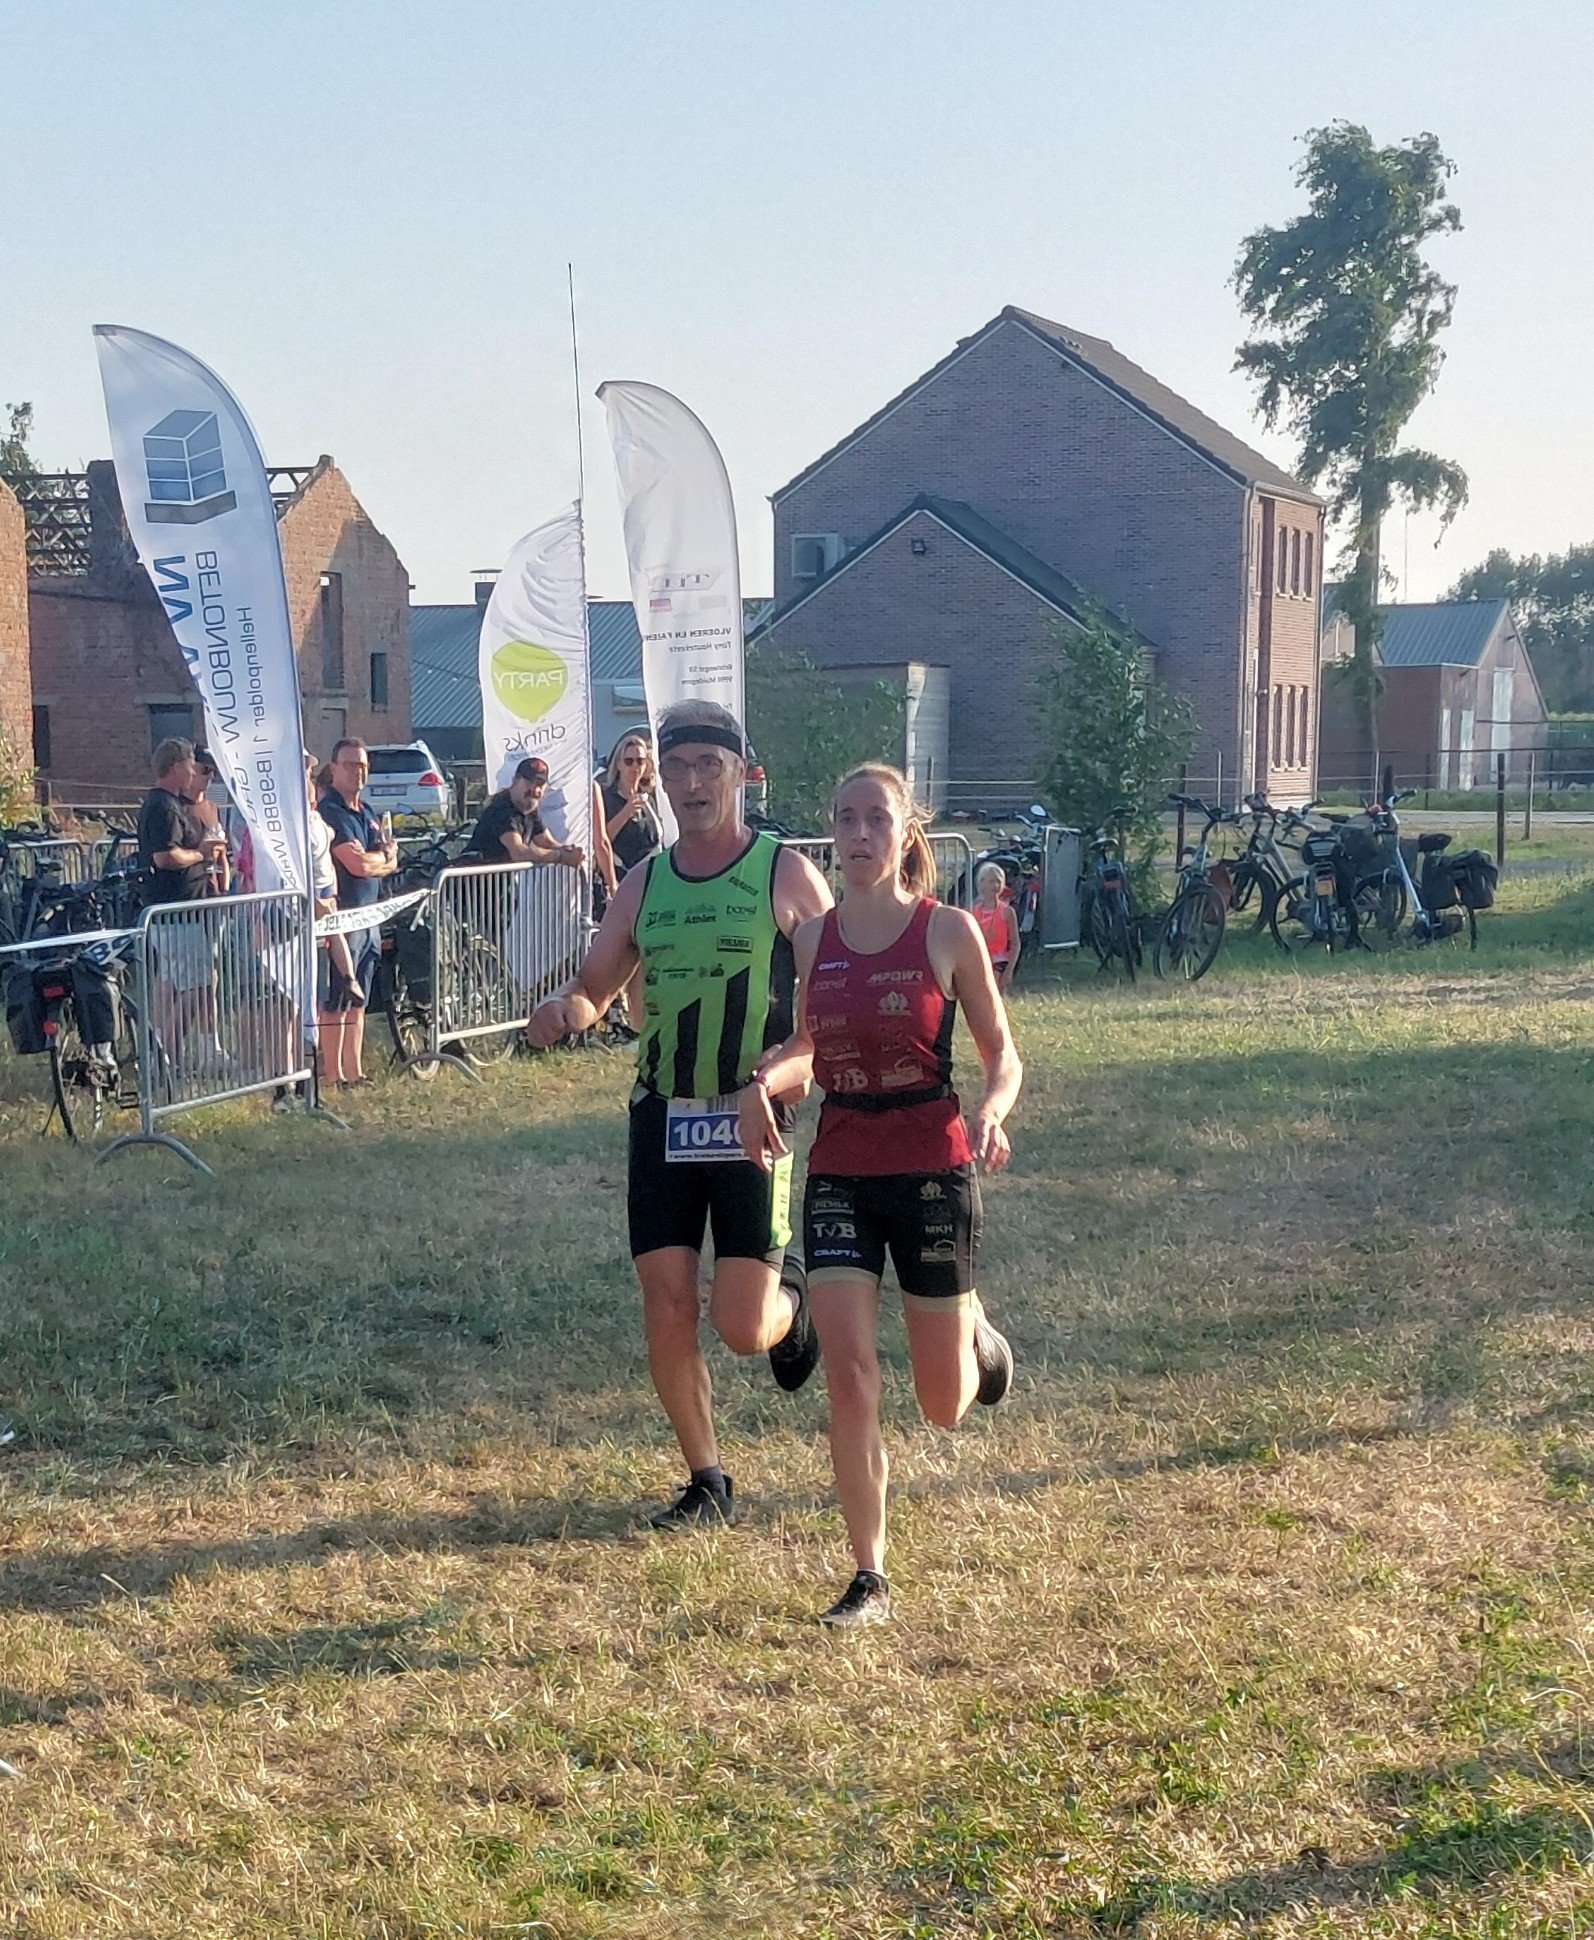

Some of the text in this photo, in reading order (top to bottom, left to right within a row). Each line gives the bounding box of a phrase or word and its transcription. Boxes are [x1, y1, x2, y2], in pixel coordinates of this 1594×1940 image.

[818, 961, 844, 971] CRAFT
[866, 970, 924, 983] MPOWR
[812, 1222, 858, 1239] TvB
